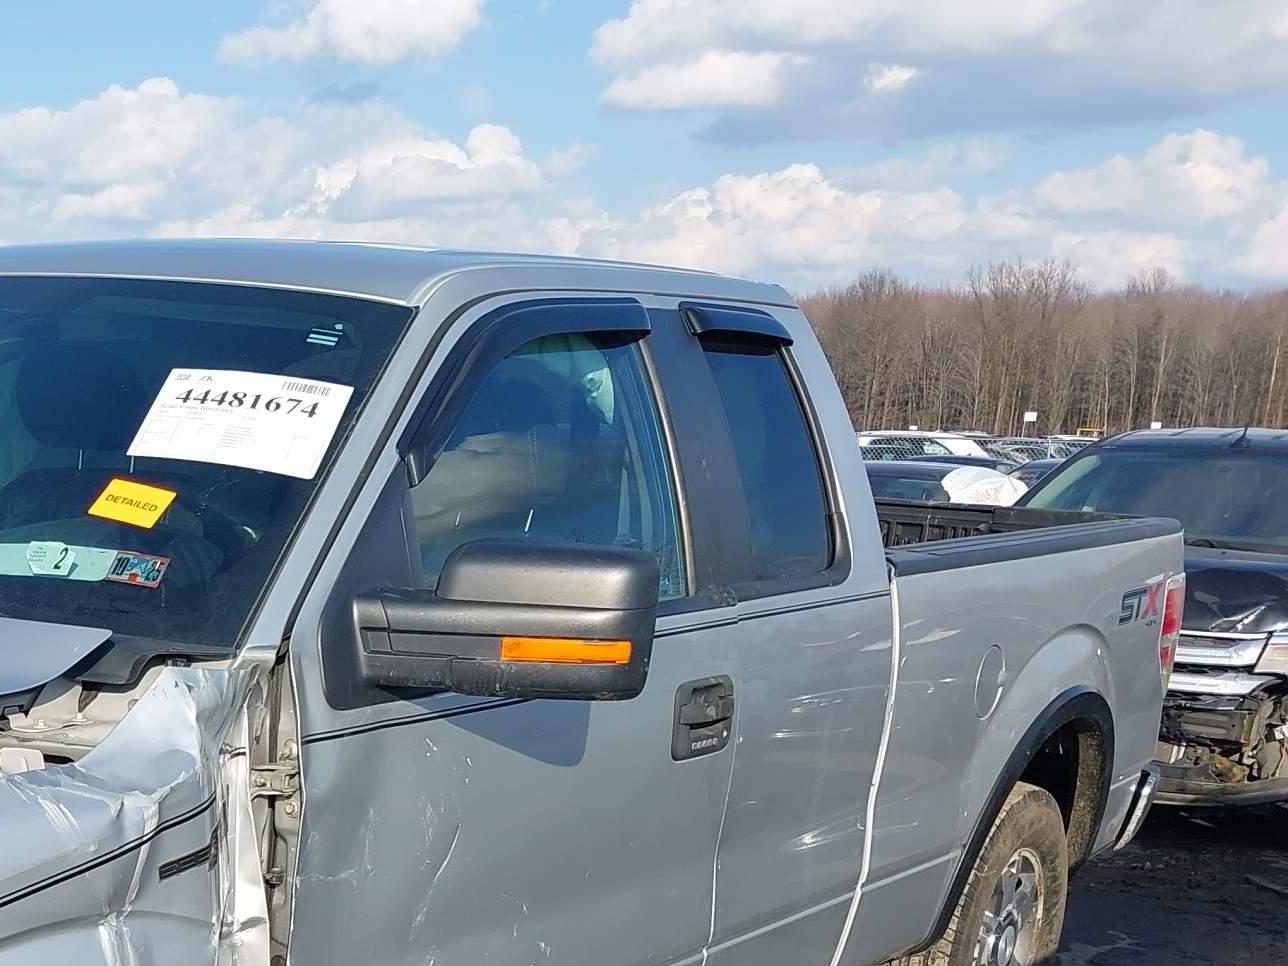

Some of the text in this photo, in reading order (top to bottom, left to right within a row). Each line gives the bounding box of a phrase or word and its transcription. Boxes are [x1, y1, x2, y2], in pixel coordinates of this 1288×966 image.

[175, 388, 320, 418] 44481674
[105, 494, 158, 512] DETAILED
[53, 547, 69, 570] 2
[1118, 582, 1163, 626] STX
